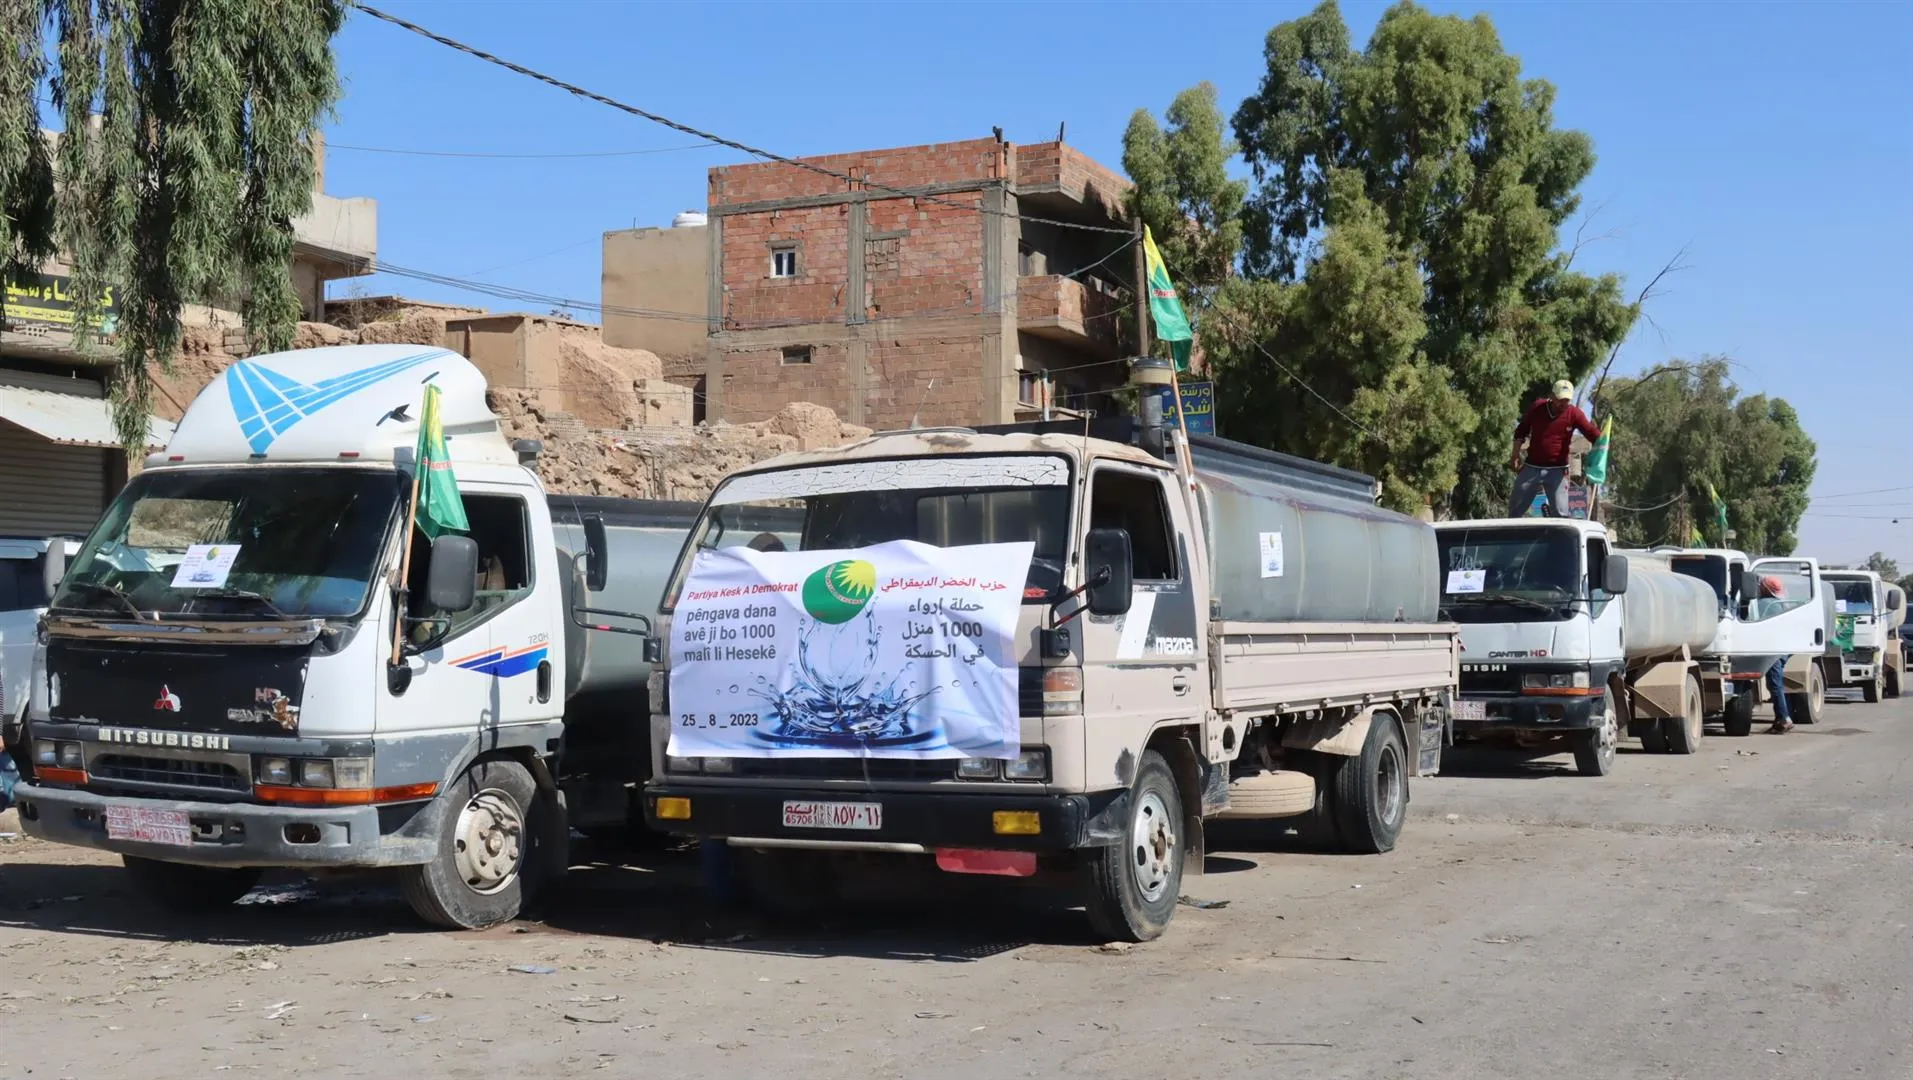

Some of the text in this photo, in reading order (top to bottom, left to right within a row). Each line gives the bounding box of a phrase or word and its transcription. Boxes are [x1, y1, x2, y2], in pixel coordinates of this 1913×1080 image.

[686, 582, 798, 600] Partiya Kesk A Demokrat
[881, 576, 1007, 592] حزب الخضر الديمقراطي
[686, 604, 777, 624] pêngava dana
[908, 597, 984, 615] حملة إرواء
[684, 623, 776, 644] avê ji bo 1000
[902, 620, 983, 640] 1000 منزل
[684, 645, 777, 662] malî li Hesekê
[905, 643, 985, 665] في الحسكة
[1488, 650, 1528, 658] CANTER
[1462, 664, 1508, 672] BISHI
[682, 714, 696, 727] 25
[708, 713, 717, 727] 8
[730, 713, 759, 727] 2023
[98, 728, 229, 750] MITSUBISHI
